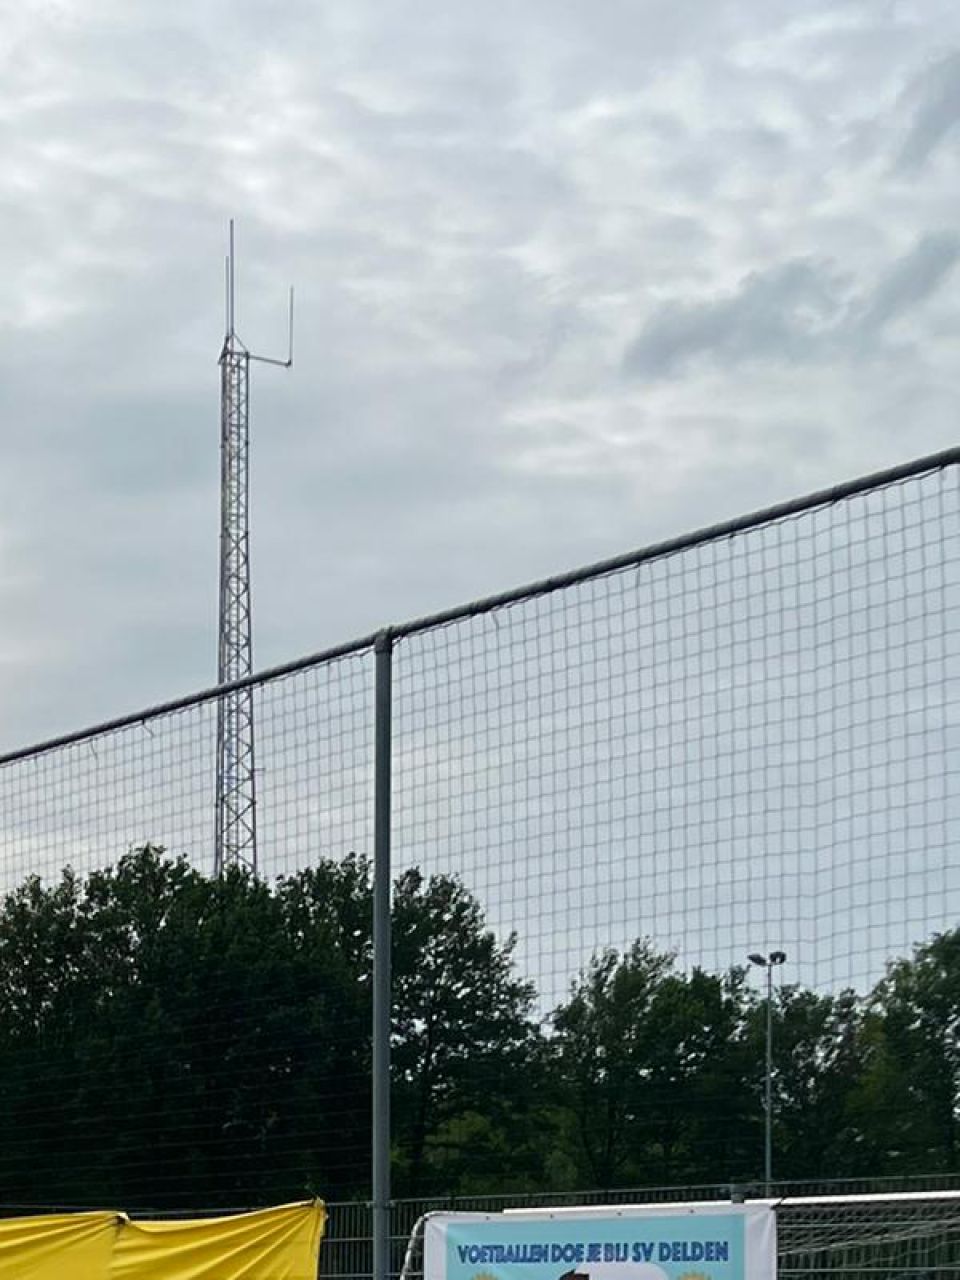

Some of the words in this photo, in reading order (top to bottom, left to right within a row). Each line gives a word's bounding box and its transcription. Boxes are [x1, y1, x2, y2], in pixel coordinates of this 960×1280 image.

[551, 1243, 584, 1263] DOE
[603, 1243, 628, 1262] BIJ
[632, 1242, 655, 1262] SV
[659, 1241, 728, 1262] DELDEN
